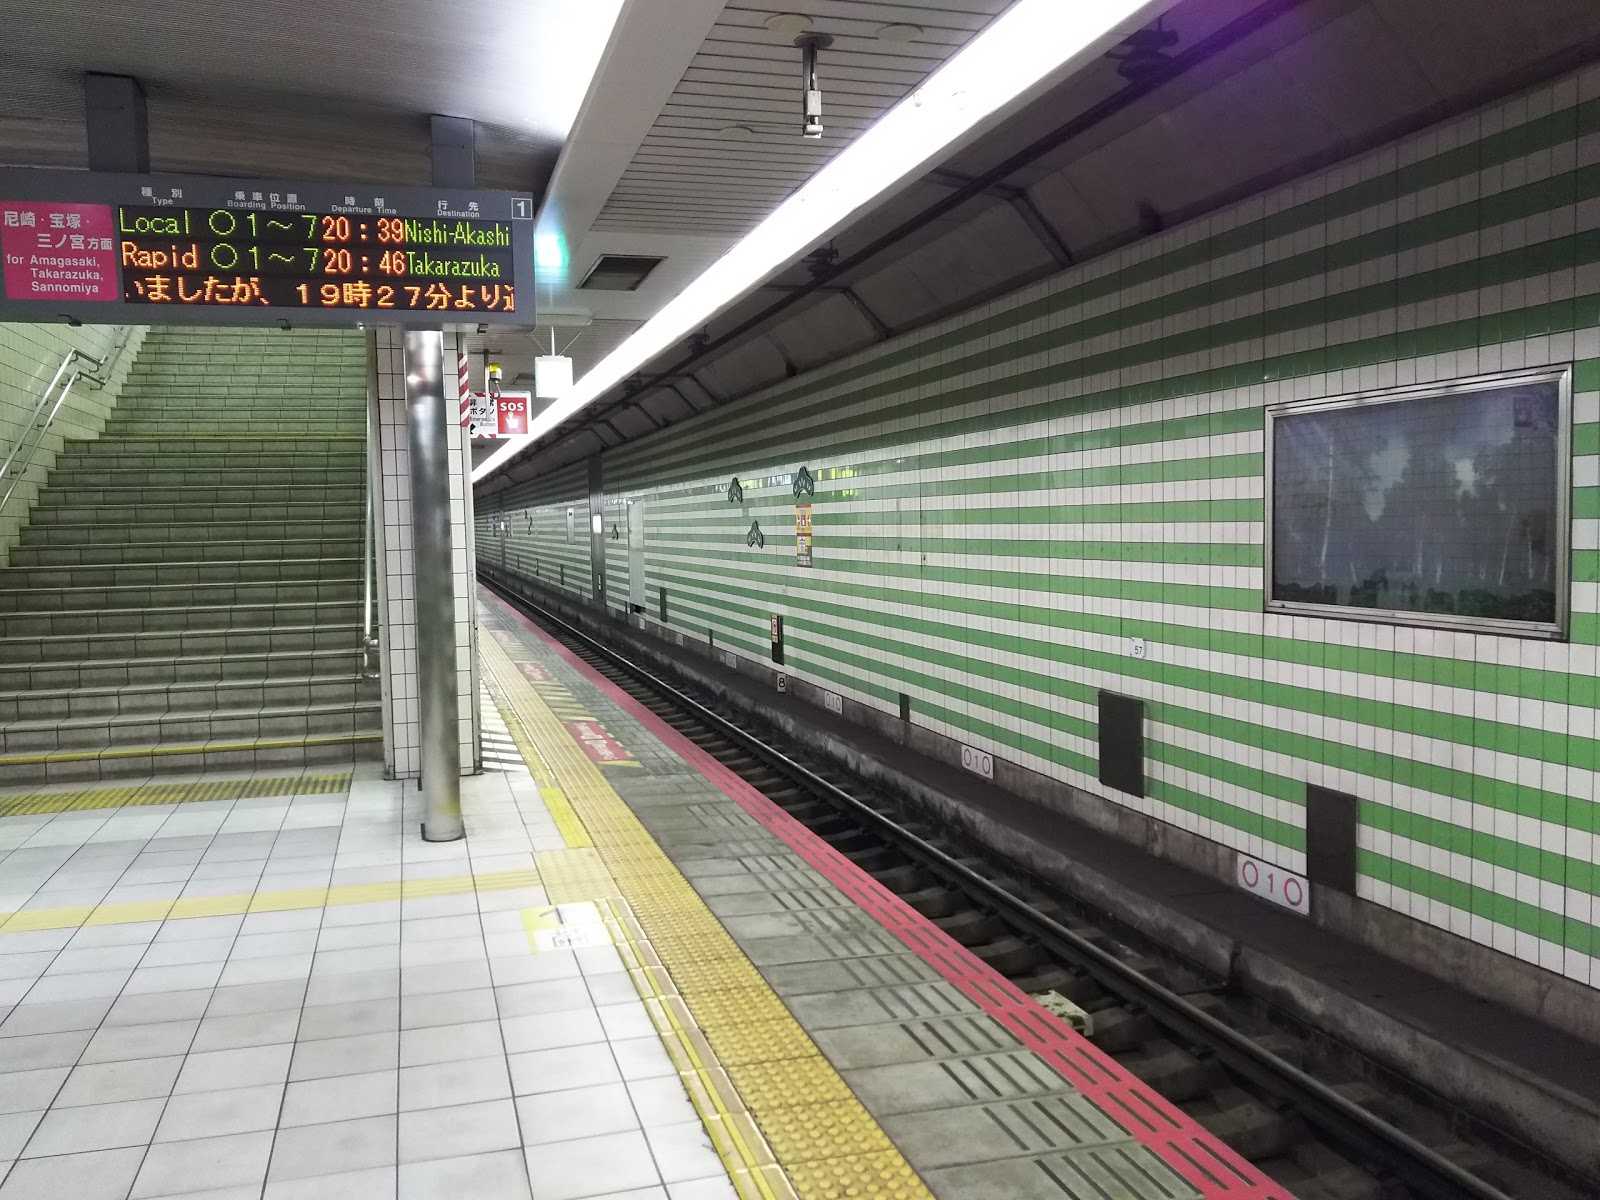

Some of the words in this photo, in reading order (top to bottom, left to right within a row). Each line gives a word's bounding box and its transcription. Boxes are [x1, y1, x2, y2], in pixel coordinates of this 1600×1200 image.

[152, 197, 174, 206] Type
[227, 199, 266, 210] Boarding
[270, 201, 306, 211] Position
[331, 204, 372, 214] Departure
[377, 206, 397, 215] Time
[437, 209, 480, 218] Destination
[516, 200, 526, 217] 1
[119, 207, 190, 235] Local
[322, 215, 404, 241] 20:39
[404, 219, 510, 247] Nishi-Akashi
[7, 254, 24, 265] for
[30, 255, 101, 268] Amagasaki,
[121, 241, 199, 269] Rapid
[323, 248, 405, 275] 20:46
[405, 252, 501, 278] Takarazuka
[31, 268, 104, 281] Takarazuka,
[31, 281, 99, 294] Sannomiya
[500, 402, 525, 412] SOS
